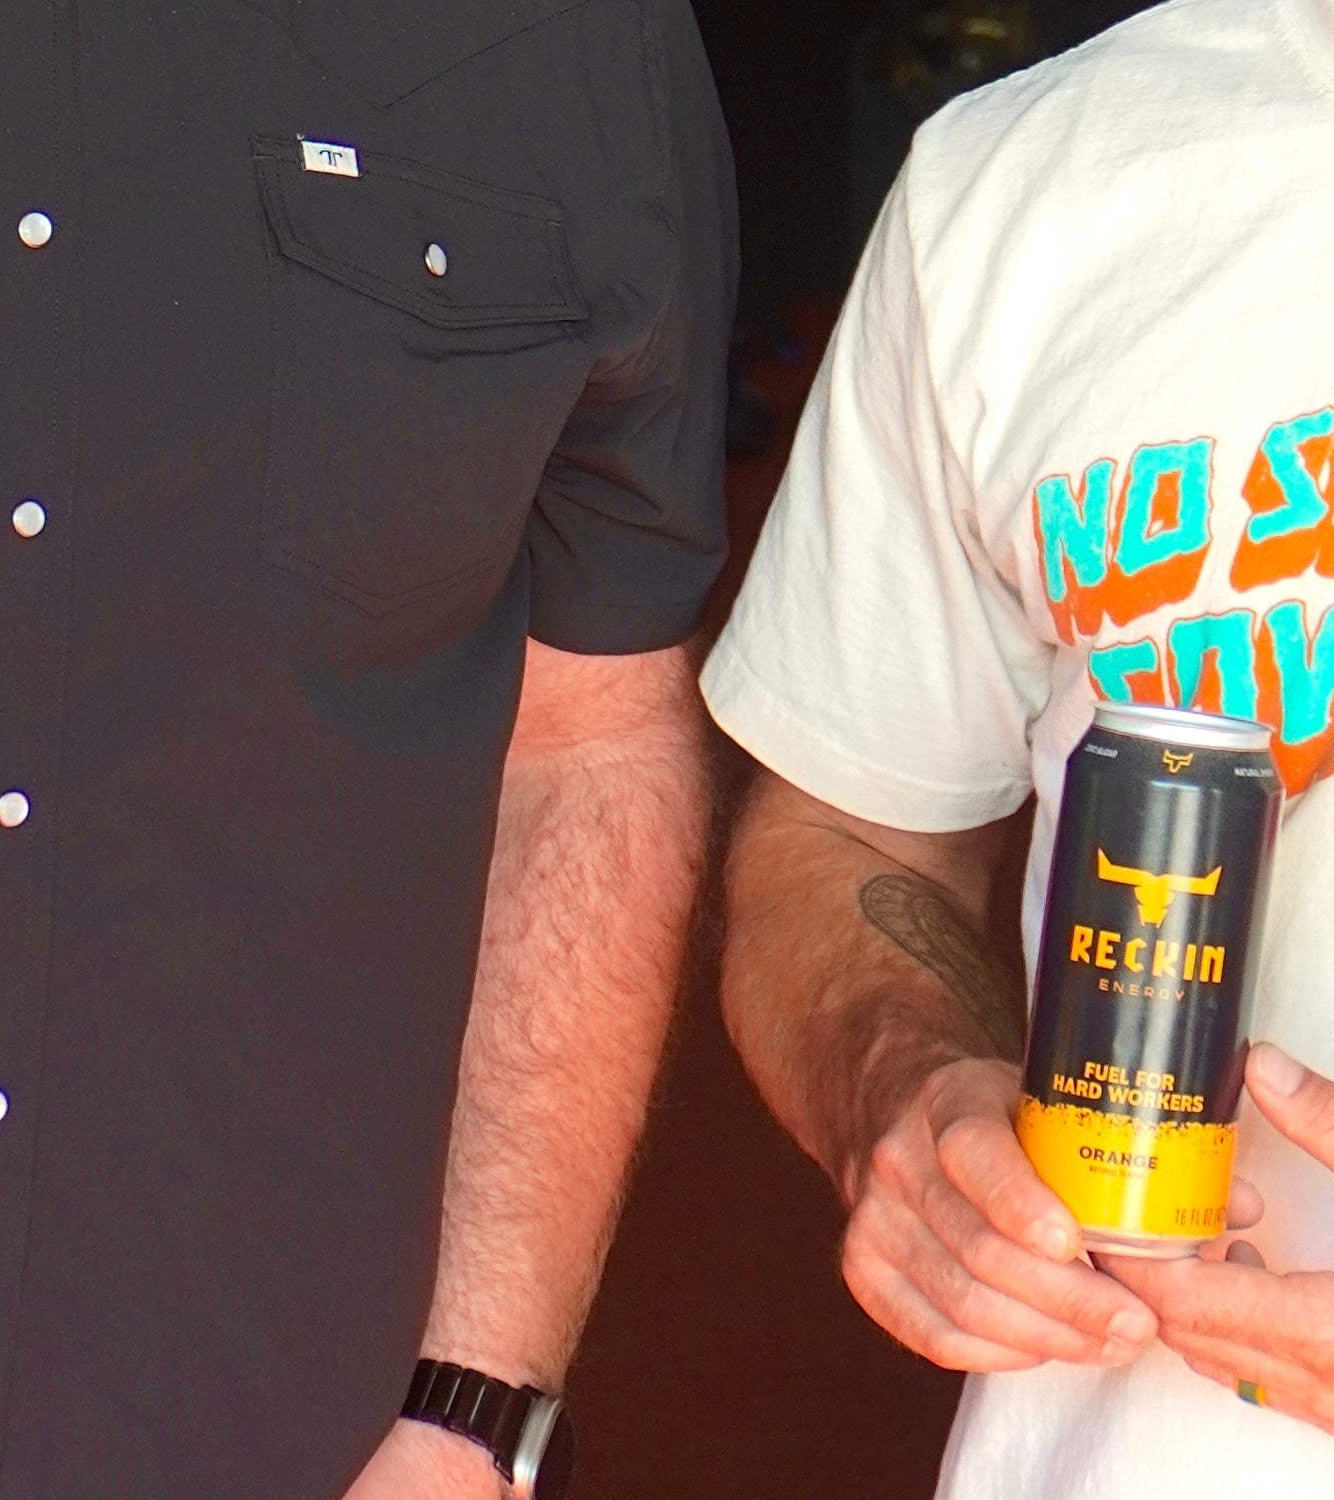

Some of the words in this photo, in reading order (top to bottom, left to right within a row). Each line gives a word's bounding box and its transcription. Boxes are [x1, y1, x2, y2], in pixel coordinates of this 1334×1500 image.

[1033, 436, 1216, 647] NO
[1069, 924, 1226, 984] RECKIN
[1097, 977, 1186, 1001] ENERGY
[1052, 1073, 1103, 1100] HARD
[1107, 1085, 1205, 1114] WORKERS
[1083, 1061, 1130, 1086] FUEL
[1135, 1070, 1176, 1092] FOR
[1078, 1145, 1159, 1171] ORANGE
